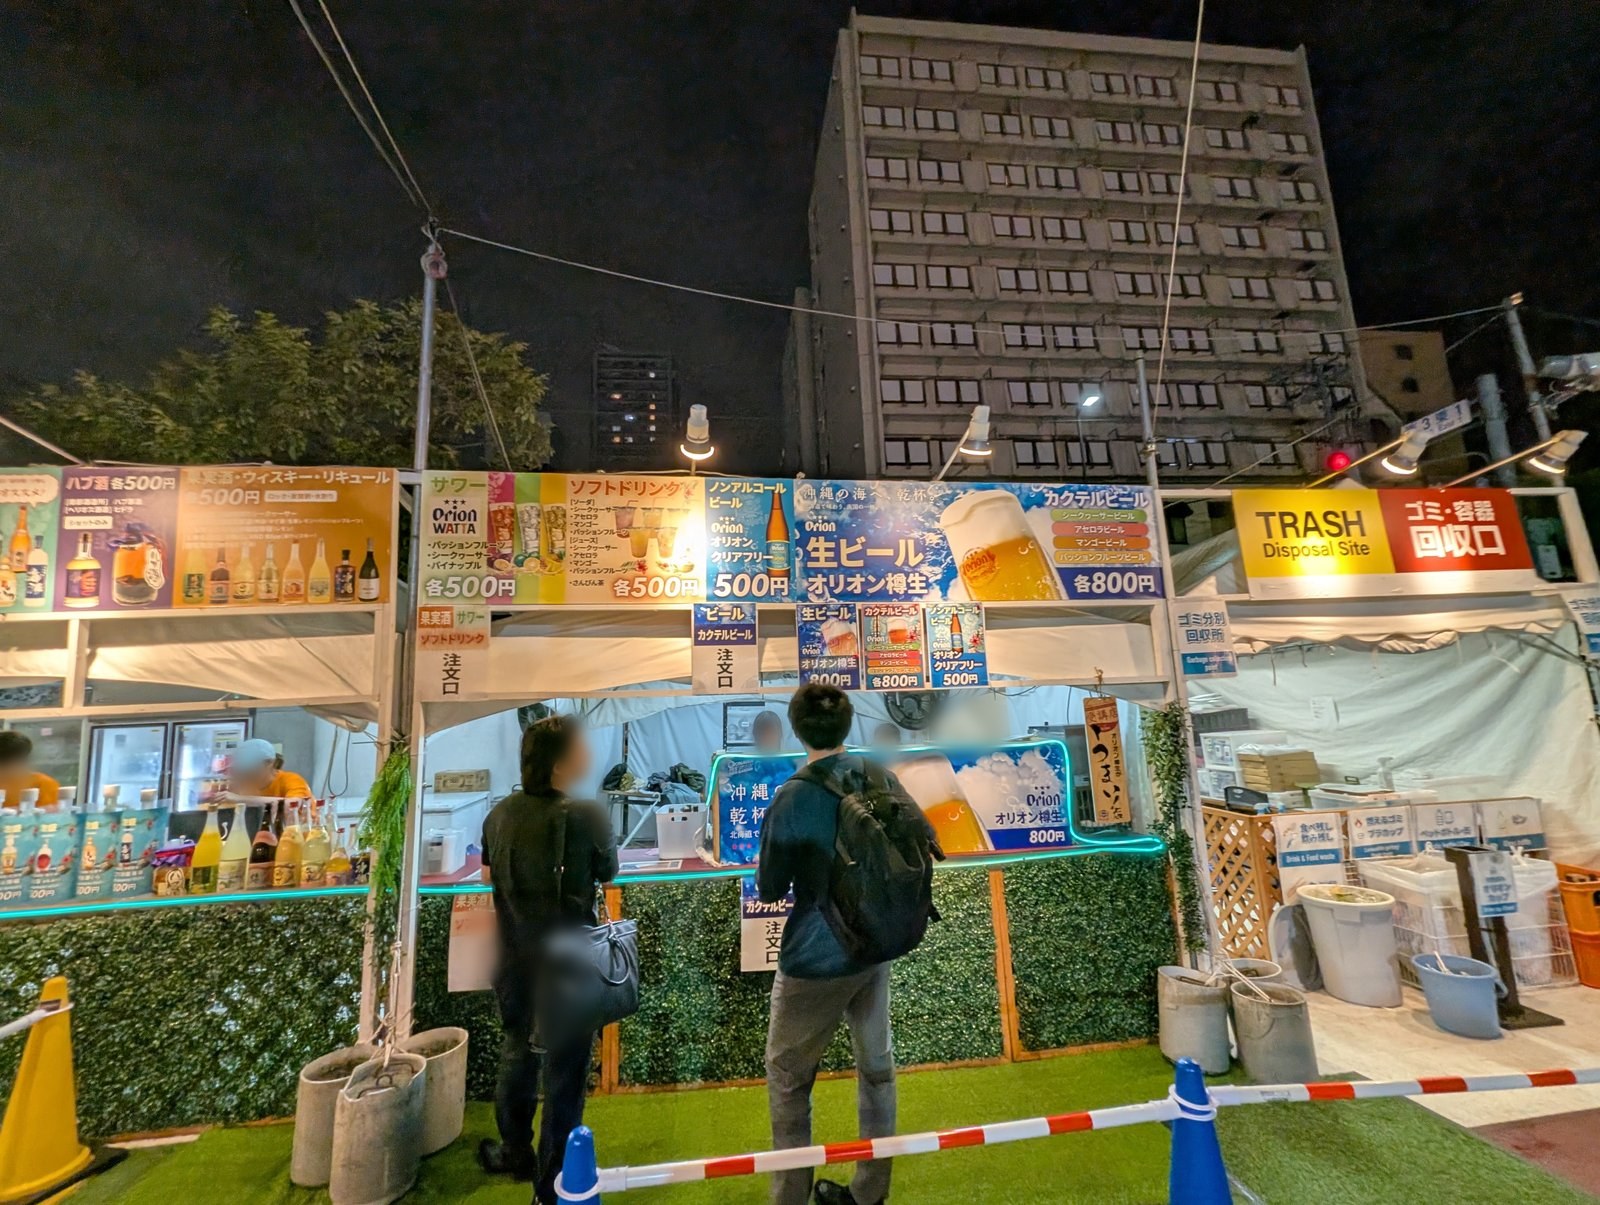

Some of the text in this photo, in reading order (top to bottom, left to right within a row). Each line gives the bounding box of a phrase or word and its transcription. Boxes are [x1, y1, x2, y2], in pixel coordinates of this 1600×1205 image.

[1422, 418, 1430, 430] 3
[66, 476, 175, 490] ハブ酒 各500円
[431, 477, 486, 493] サワー
[571, 480, 680, 497] ソフトドリンク
[709, 482, 787, 494] ノンアルコール
[709, 497, 742, 508] ビール
[1045, 490, 1149, 508] カクテルビール
[433, 506, 477, 522] Orion
[1405, 500, 1495, 522] ゴミ・容器
[433, 523, 476, 534] WATTA
[711, 521, 743, 533] Orion
[805, 519, 836, 532] Orion
[1074, 525, 1126, 534] アセロラビール
[1256, 510, 1367, 539] TRASH
[573, 528, 629, 536] パッションフルーツ
[432, 541, 506, 550] パッションフルーツ
[711, 537, 753, 547] オリオン
[1076, 538, 1128, 547] マンゴービール
[1410, 524, 1506, 558] 回収口
[711, 552, 774, 563] クリアフリー
[806, 536, 925, 568] 生ビール
[1059, 552, 1147, 562] パッションフルーツビール
[1263, 540, 1370, 562] Disposal Site
[431, 561, 482, 570] パイナップル
[425, 576, 516, 598] 各500円
[613, 576, 700, 598] 各500円
[713, 573, 788, 597] 500円
[807, 572, 930, 595] オリオン樽生
[1074, 572, 1156, 594] 各800円
[706, 607, 745, 621] ビール
[802, 608, 851, 621] 生ビール
[864, 607, 918, 616] カクテルビール
[929, 606, 981, 615] ノンアルコール
[420, 611, 484, 625] 果実酒 サワー
[930, 618, 952, 626] ビール
[1178, 612, 1226, 626] ゴミ分別
[420, 633, 485, 646] ソフトドリンク
[698, 629, 753, 641] カクテルビール
[1185, 629, 1225, 643] 回収所
[933, 651, 962, 660] オリオン
[717, 648, 733, 688] 注文口
[801, 658, 857, 669] オリオン樽生
[934, 661, 984, 672] クリアフリー
[442, 653, 461, 695] 注文口
[943, 673, 978, 686] 500円
[872, 675, 918, 688] 各800円
[1027, 791, 1061, 806] Orion
[995, 811, 1064, 825] オリオン樽生
[1029, 830, 1066, 843] 800円
